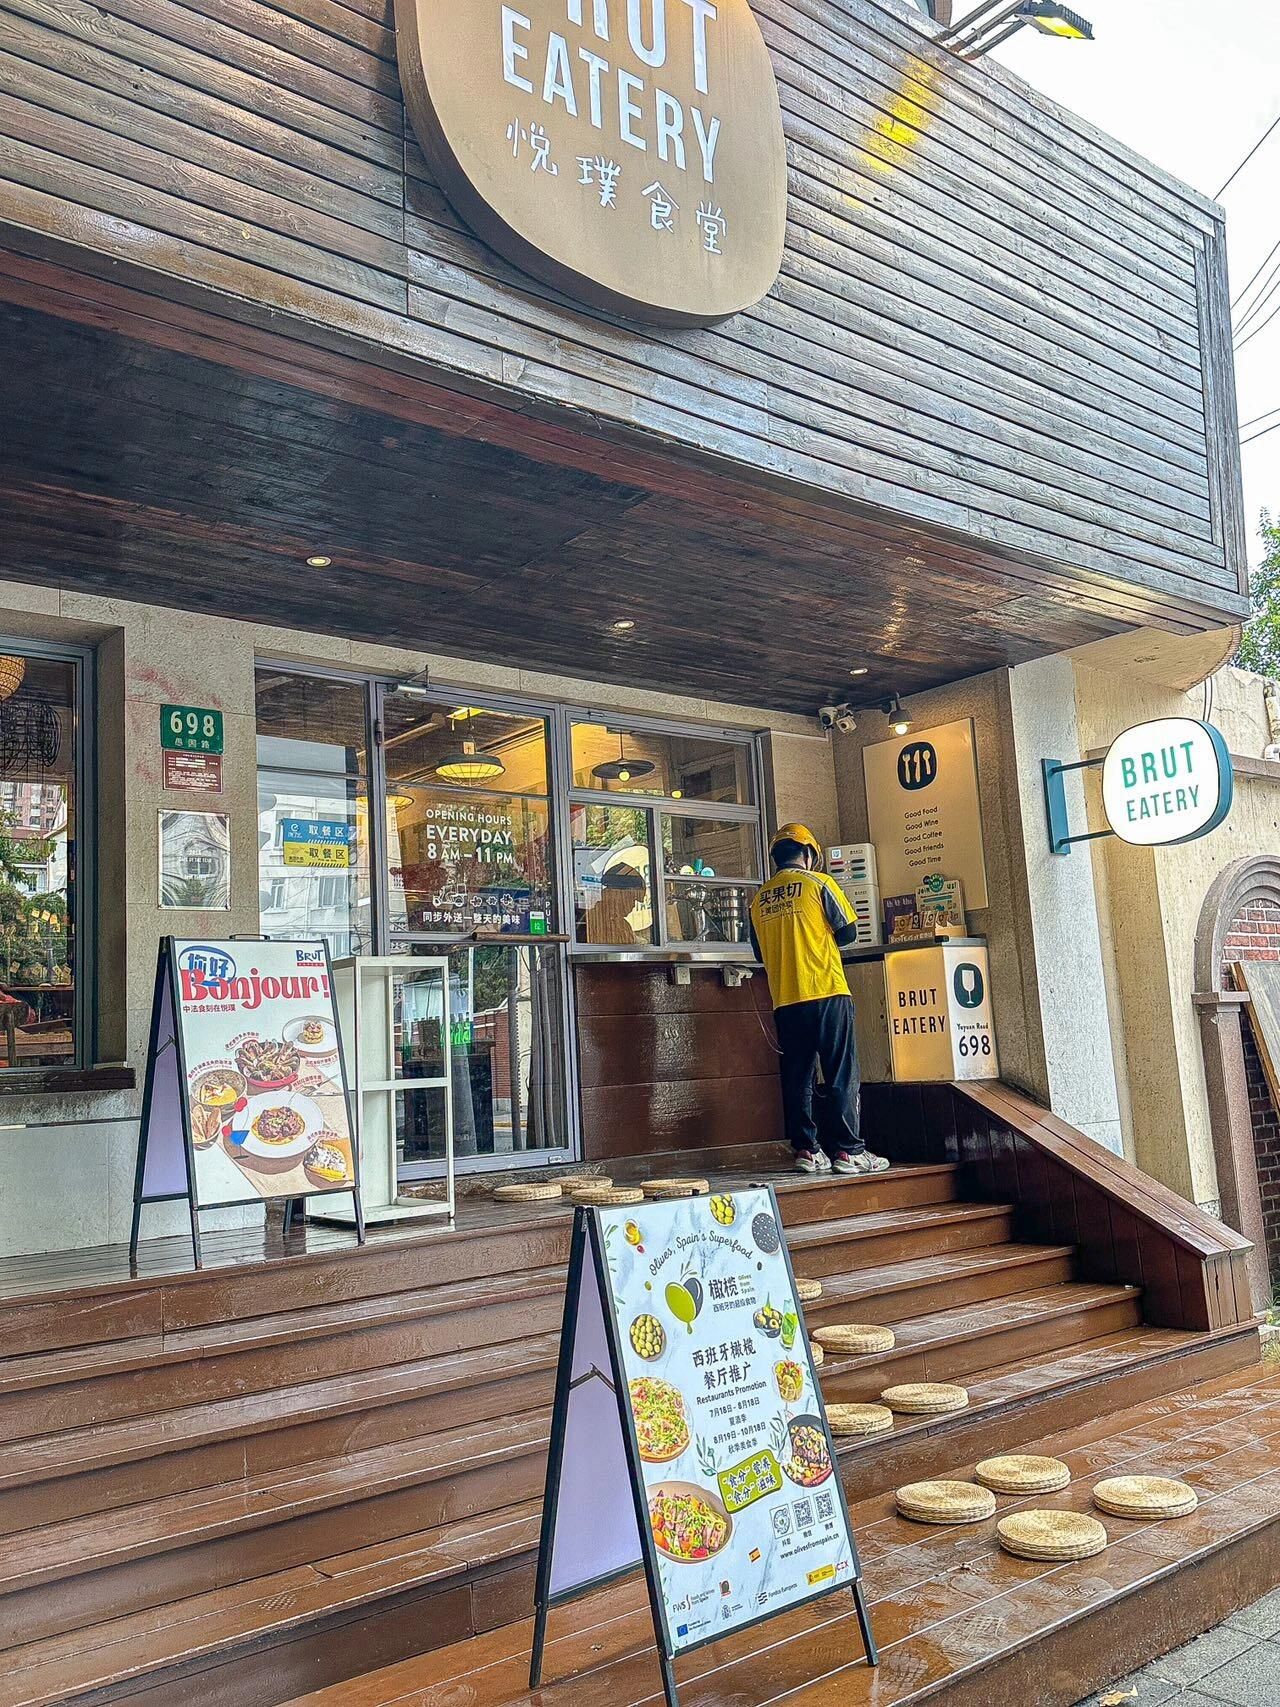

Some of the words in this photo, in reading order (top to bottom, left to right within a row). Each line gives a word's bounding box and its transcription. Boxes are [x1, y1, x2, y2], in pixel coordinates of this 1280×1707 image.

[501, 4, 721, 184] EATERY
[506, 116, 727, 255] 悦璞食堂
[171, 711, 215, 737] 698
[1121, 741, 1194, 789] BRUT
[904, 810, 921, 819] Good
[923, 806, 938, 815] Food
[1127, 785, 1199, 822] EATERY
[426, 809, 474, 822] OPENING
[476, 813, 512, 826] HOURS
[905, 822, 922, 831] Good
[924, 819, 939, 827] Wine
[309, 825, 345, 837] 取餐区
[426, 825, 512, 845] EVERYDAY
[904, 834, 921, 843] Good
[922, 831, 942, 840] Coffee
[309, 848, 345, 860] 取餐区
[427, 843, 437, 859] 8
[441, 849, 460, 860] AM
[475, 847, 491, 863] 11
[496, 852, 513, 864] PM
[904, 846, 922, 855] Good
[923, 843, 944, 852] Friends
[909, 858, 926, 867] Good
[759, 882, 803, 907] 买果切
[423, 911, 521, 925] 同步外送一整天的美味
[187, 953, 229, 978] 你好
[180, 968, 330, 1010] Bonjour!
[898, 988, 937, 1007] BRUT
[893, 1015, 946, 1035] EATERY
[956, 1023, 975, 1032] Yuyuan
[977, 1022, 989, 1030] Road
[959, 1034, 991, 1056] 698
[649, 1248, 677, 1276] Olives,
[676, 1229, 708, 1251] Spain's
[709, 1230, 753, 1259] Superfood
[708, 1276, 739, 1300] 橄榄
[692, 1337, 756, 1368] 西班牙橄榄
[704, 1361, 751, 1390] 餐厅推广
[697, 1389, 735, 1405] Restaurants
[735, 1380, 767, 1395] Promotion
[709, 1404, 733, 1418] 7月18日
[737, 1397, 760, 1410] 8月18日
[713, 1430, 737, 1444] 8月19日
[741, 1421, 766, 1436] 10月18日
[752, 1456, 771, 1476] 营养
[672, 1600, 687, 1613] FWS
